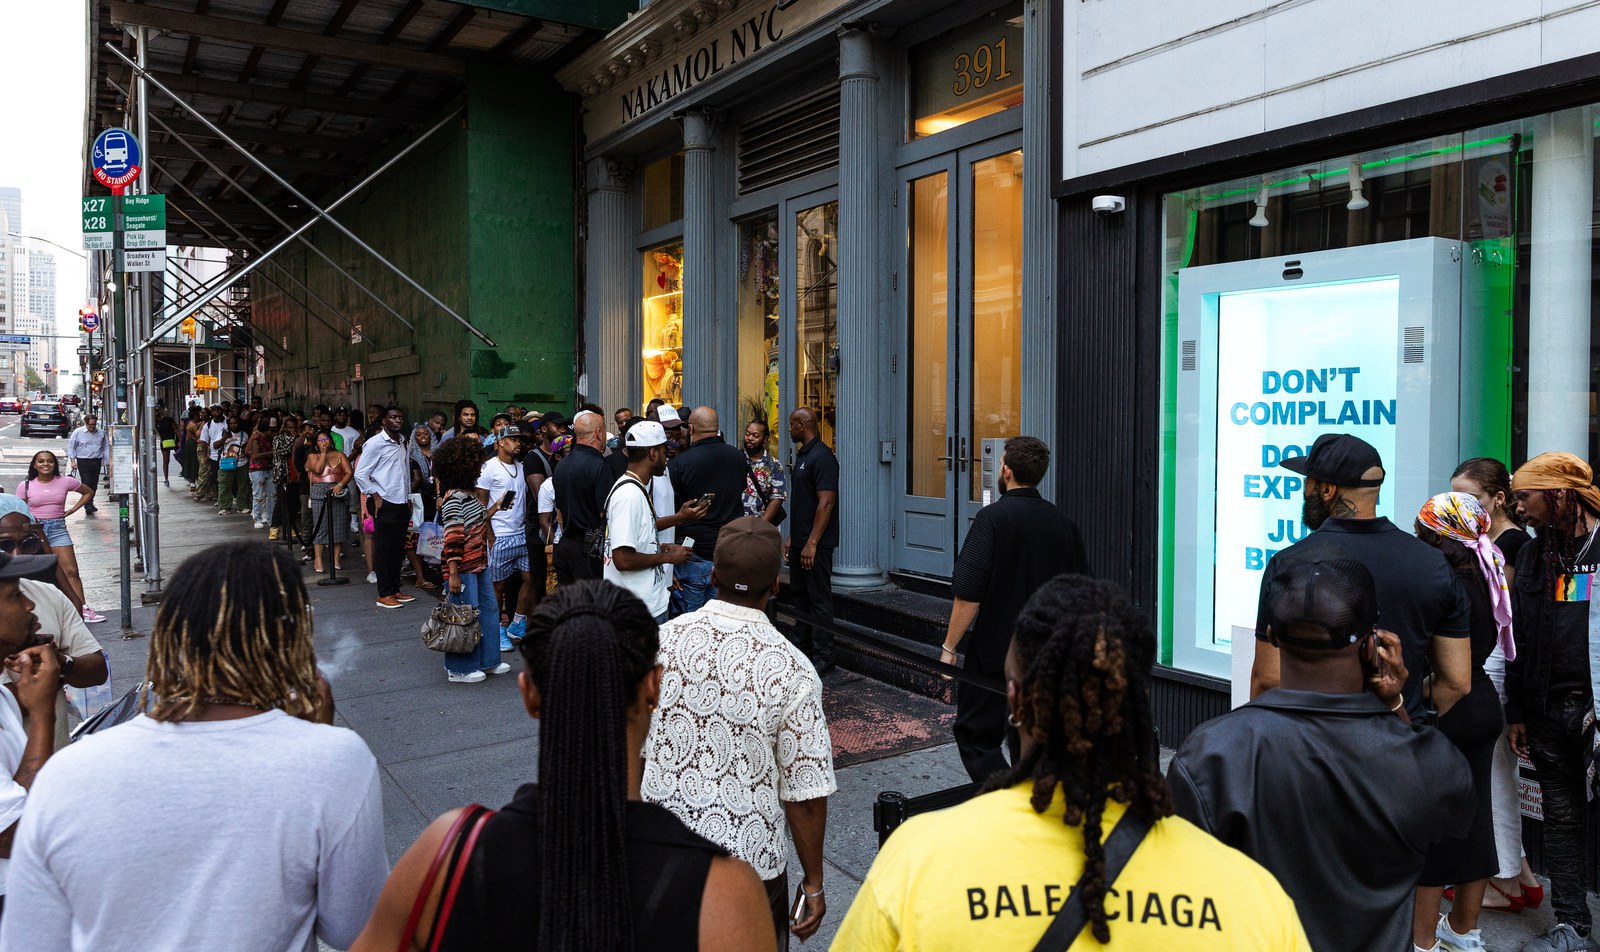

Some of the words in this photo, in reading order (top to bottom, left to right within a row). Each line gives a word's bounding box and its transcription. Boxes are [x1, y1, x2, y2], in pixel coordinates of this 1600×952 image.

[621, 38, 725, 124] NAKAMOL
[730, 4, 783, 65] NYC
[953, 35, 1011, 96] 391
[97, 169, 107, 180] NO
[106, 167, 138, 185] STANDING
[135, 197, 149, 205] Ridge
[1230, 399, 1397, 426] COMPLAIN
[1243, 474, 1304, 500] EXP
[1267, 519, 1315, 544] JU
[966, 885, 1223, 932] BALECIAGA
